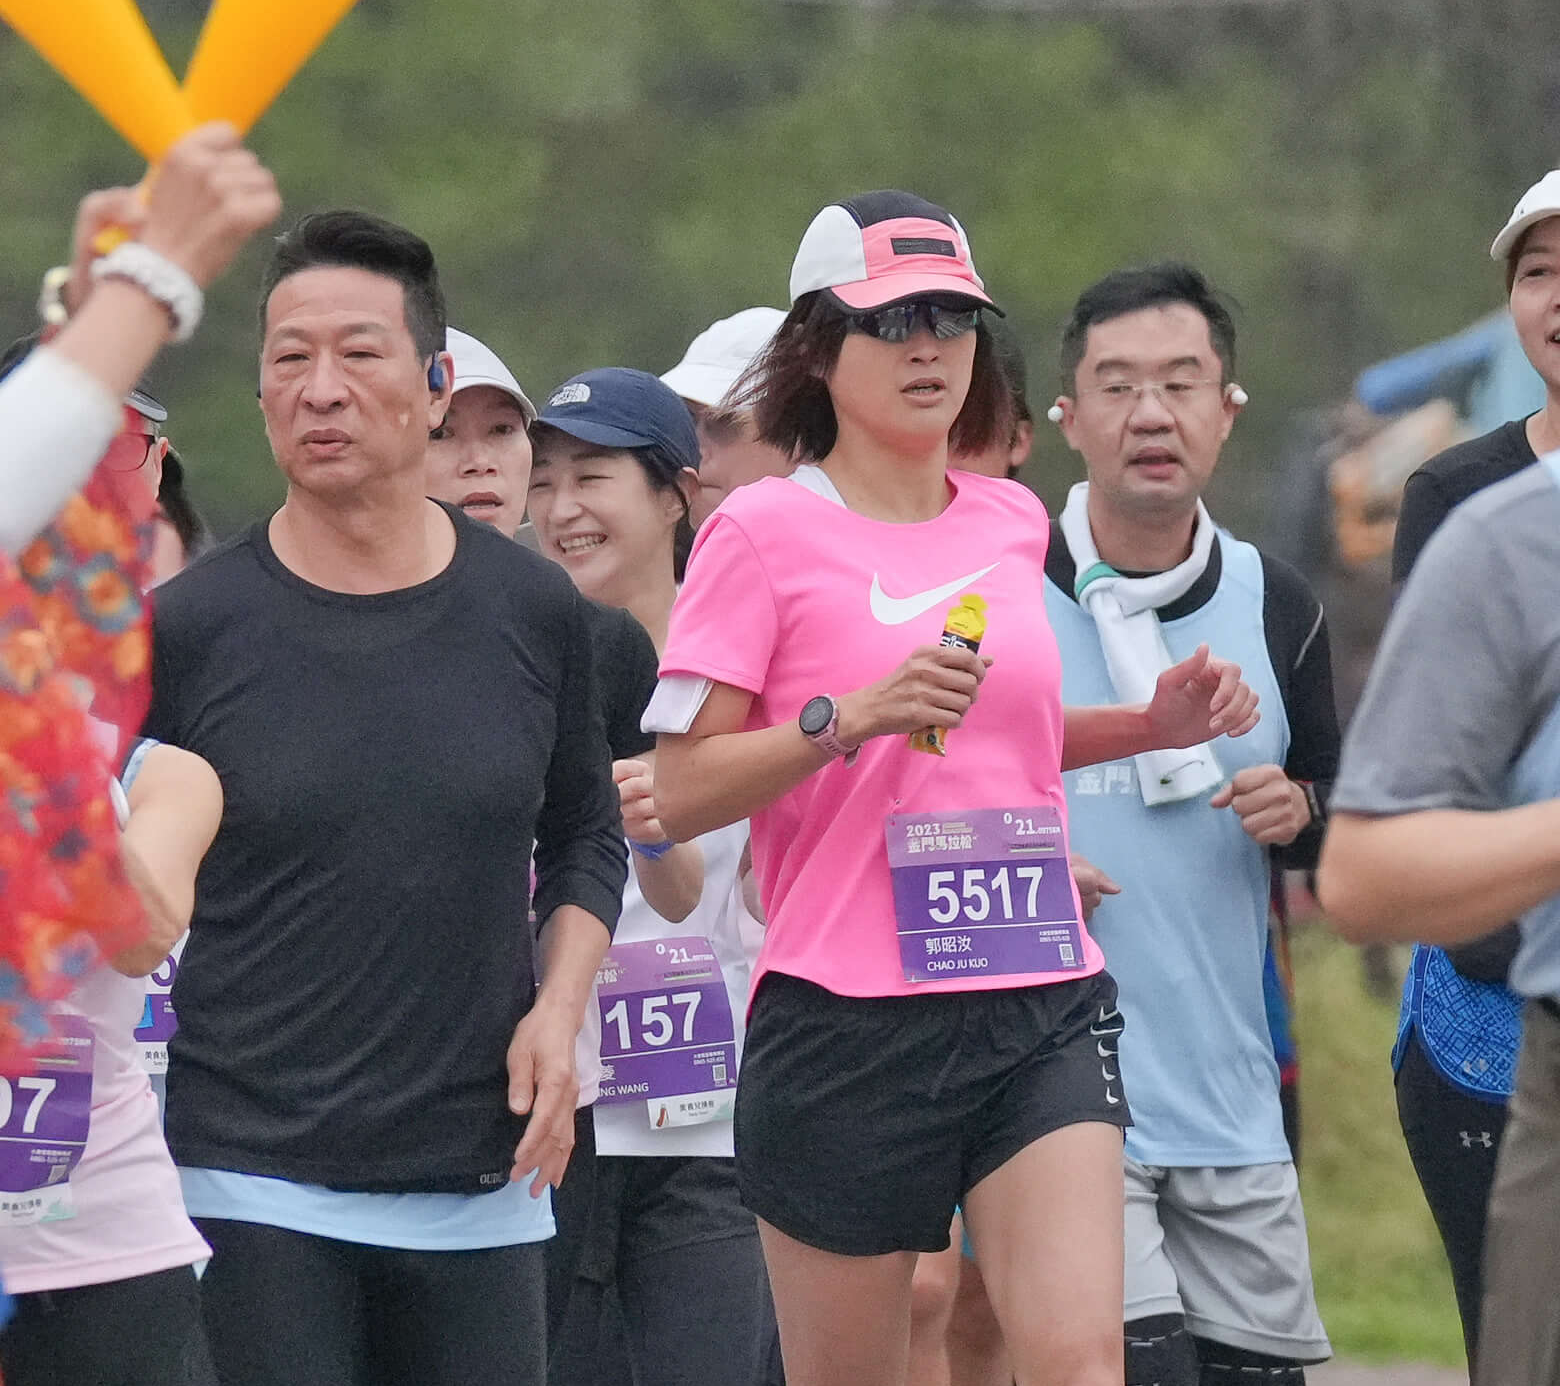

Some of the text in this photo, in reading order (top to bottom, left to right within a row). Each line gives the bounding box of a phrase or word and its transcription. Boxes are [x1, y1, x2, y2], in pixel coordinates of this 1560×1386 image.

[906, 823, 941, 838] 2023
[928, 866, 1043, 924] 5517
[925, 935, 973, 955] 郭昭汝
[927, 957, 989, 972] CHAO JU KUO
[617, 1082, 650, 1096] WANG
